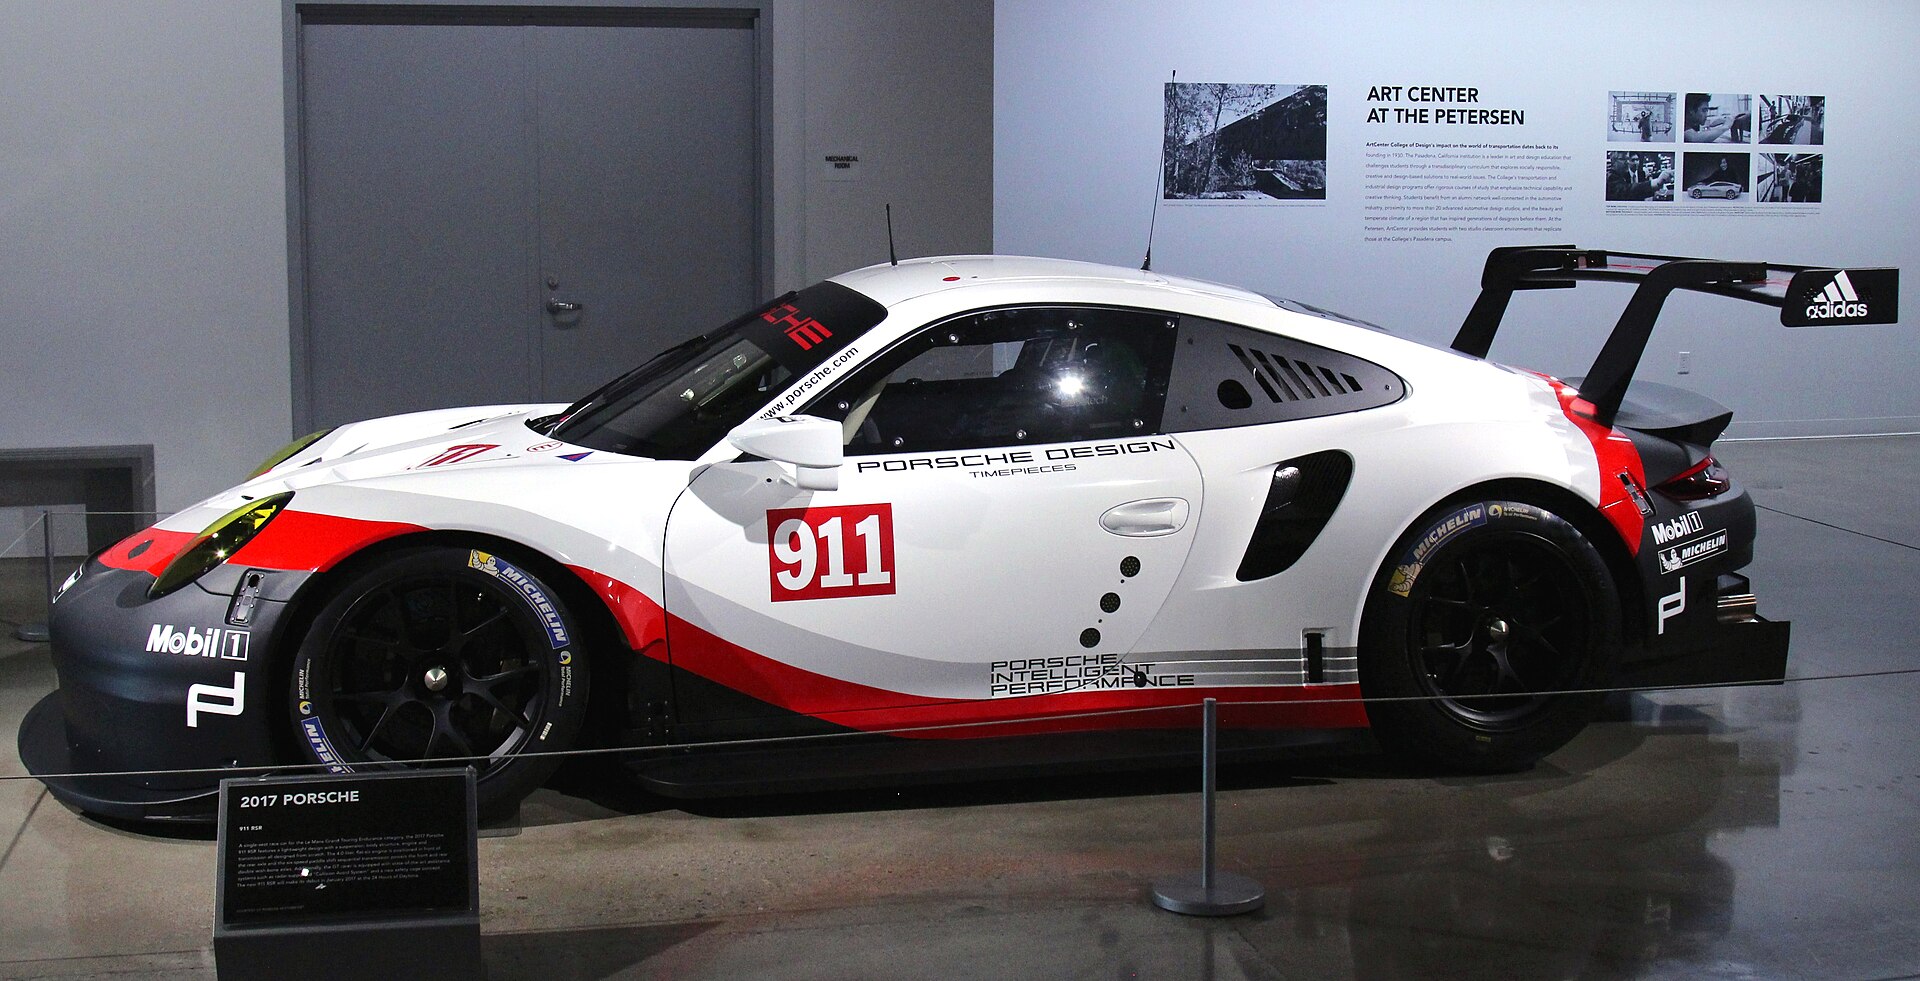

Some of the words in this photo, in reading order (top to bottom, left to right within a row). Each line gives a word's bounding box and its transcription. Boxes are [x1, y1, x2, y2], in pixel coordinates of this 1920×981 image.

[1367, 87, 1402, 101] ART
[1408, 87, 1478, 102] CENTER
[1367, 109, 1389, 123] AT
[1394, 109, 1428, 123] THE
[1436, 110, 1524, 125] PETERSEN
[1806, 301, 1867, 319] adidas
[758, 346, 859, 420] ww.porsche.com
[857, 452, 1034, 473] PORSCHE
[1046, 440, 1175, 461] DESIGN
[969, 464, 1076, 478] TIMEPIECES
[1413, 508, 1480, 560] MICHELIN
[1651, 514, 1691, 545] Mobil
[774, 515, 890, 590] 911
[1682, 535, 1725, 559] MICHELIN
[502, 567, 567, 642] MICHELIN
[146, 624, 221, 658] Mobil
[991, 653, 1118, 672] PORSCHE
[991, 664, 1156, 684] INTELLIGENT
[240, 795, 278, 808] 2017
[283, 790, 360, 806] PORSCHE
